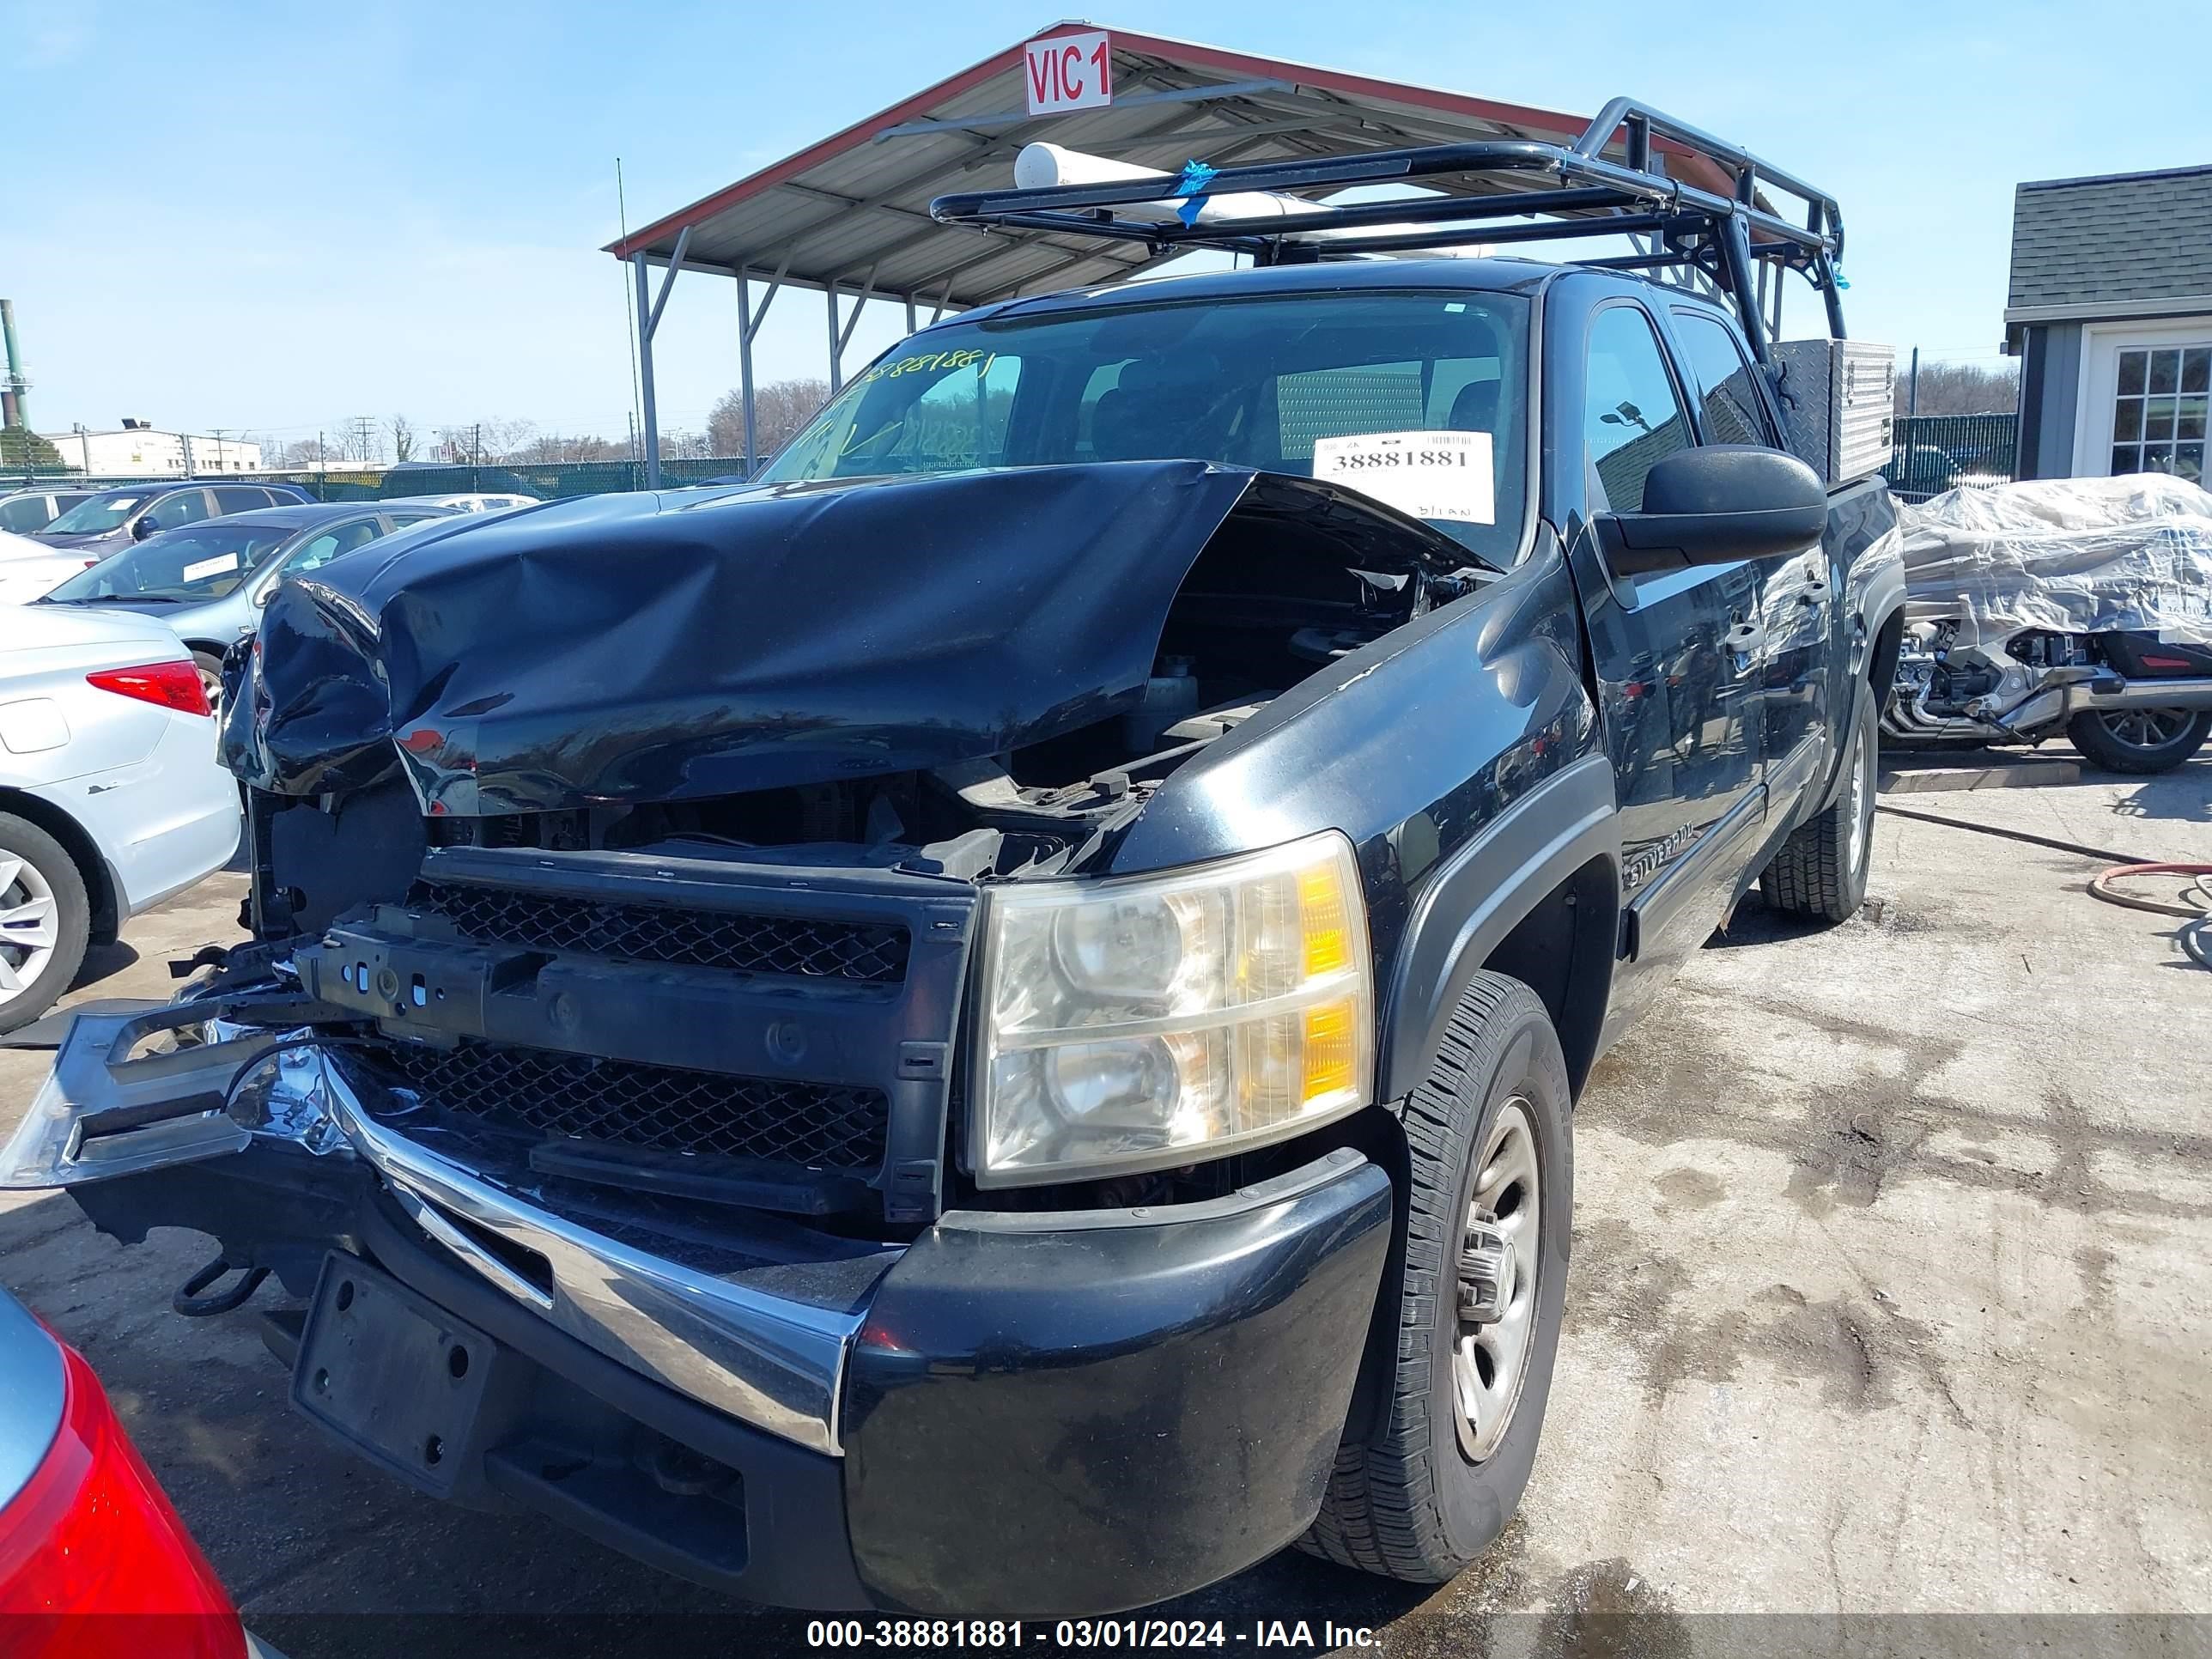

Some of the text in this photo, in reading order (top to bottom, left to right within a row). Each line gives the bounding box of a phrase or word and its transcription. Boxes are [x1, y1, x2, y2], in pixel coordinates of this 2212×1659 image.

[1028, 40, 1109, 104] VIC 1
[1333, 451, 1466, 471] 38881881
[1628, 821, 1694, 888] SILVERADO
